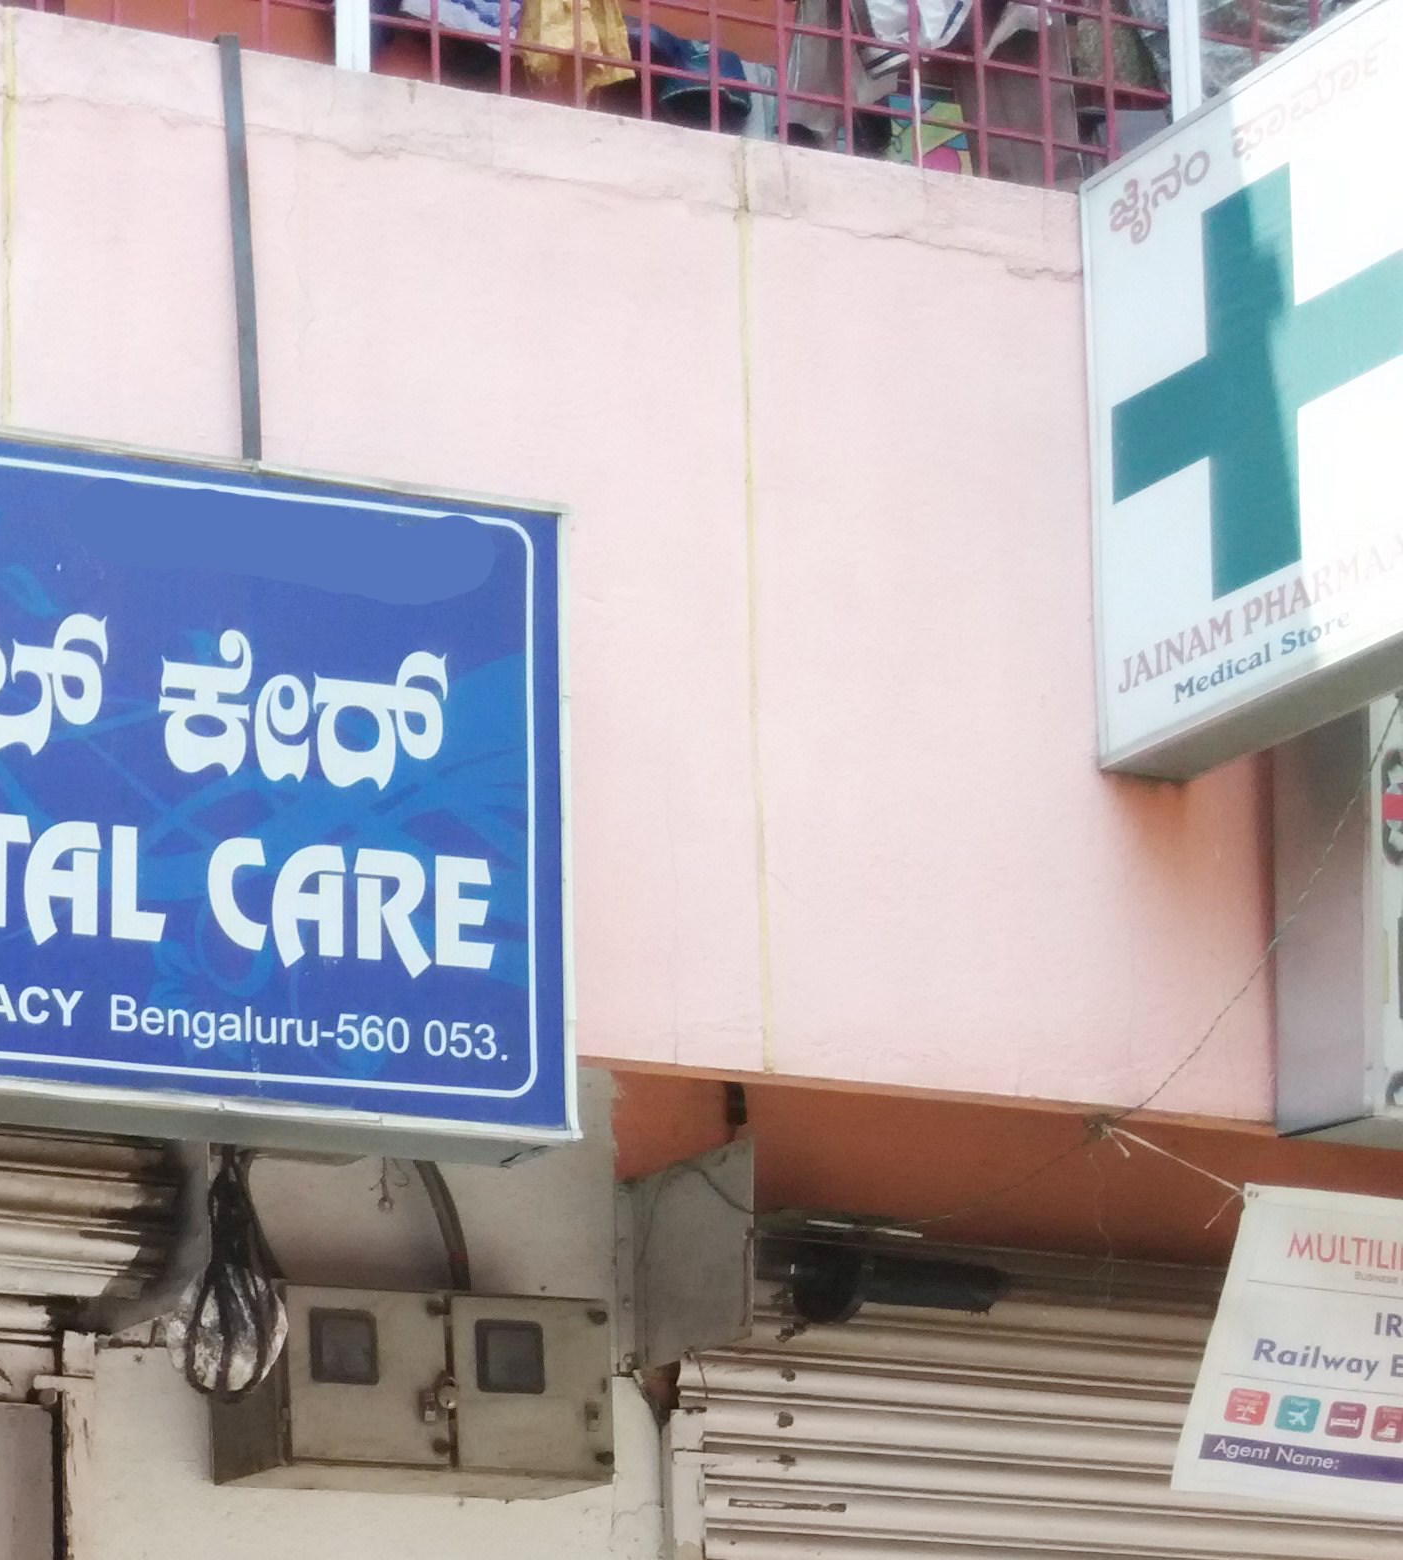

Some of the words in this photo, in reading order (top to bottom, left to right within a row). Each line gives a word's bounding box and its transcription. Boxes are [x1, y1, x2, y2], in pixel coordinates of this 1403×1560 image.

[1118, 609, 1232, 694] JAINAM
[1173, 643, 1270, 704] Medical
[1281, 611, 1350, 655] Store
[159, 629, 448, 790] ಕೇರ್
[208, 837, 494, 978] CARE
[111, 995, 409, 1053] Bengaluru-560
[425, 1020, 507, 1060] 053.
[1287, 1232, 1403, 1270] MULTILI
[1253, 1338, 1379, 1381] Railway
[1214, 1438, 1270, 1461] Agent
[1276, 1445, 1339, 1471] Name:
